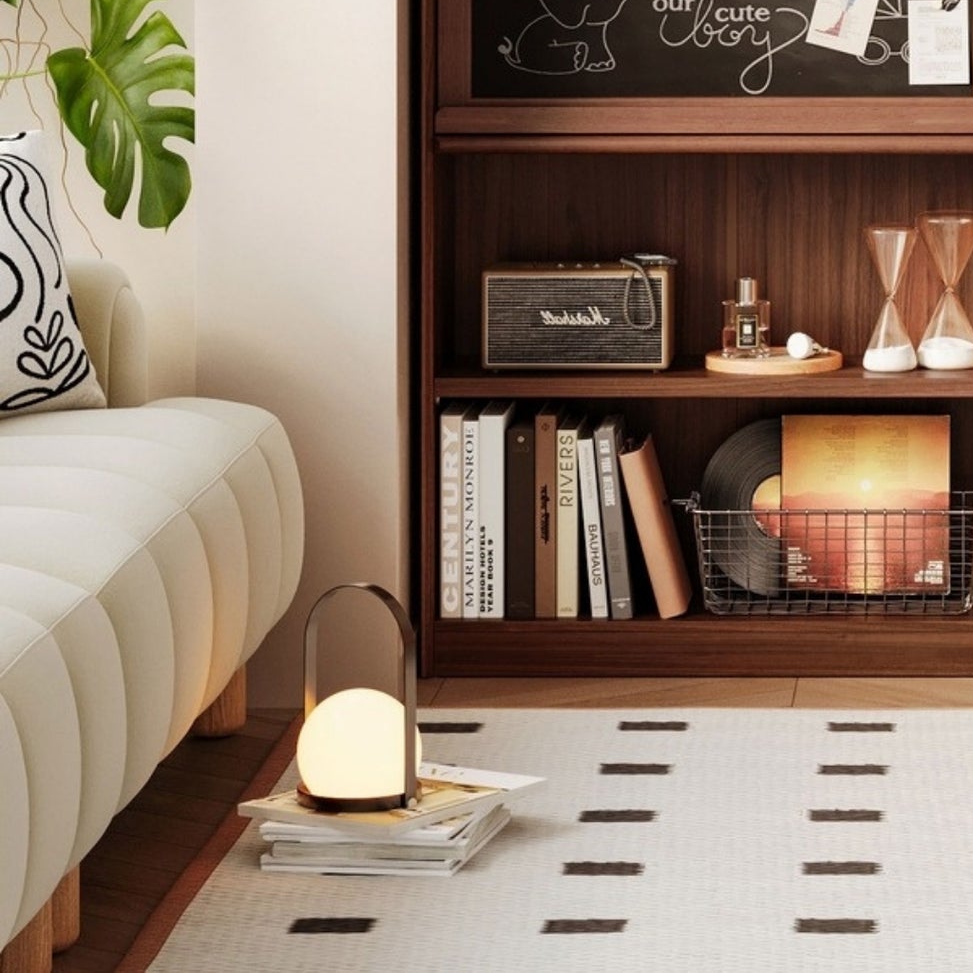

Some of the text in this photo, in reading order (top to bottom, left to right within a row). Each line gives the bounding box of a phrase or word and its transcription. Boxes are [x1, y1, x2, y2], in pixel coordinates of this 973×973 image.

[715, 4, 770, 22] cute
[560, 435, 574, 507] RIVERS
[599, 439, 610, 454] NEW
[601, 457, 612, 473] YORK
[444, 425, 458, 612] CENTURY
[465, 427, 474, 607] MARILYN MONROE
[588, 524, 602, 587] BAUHAUS
